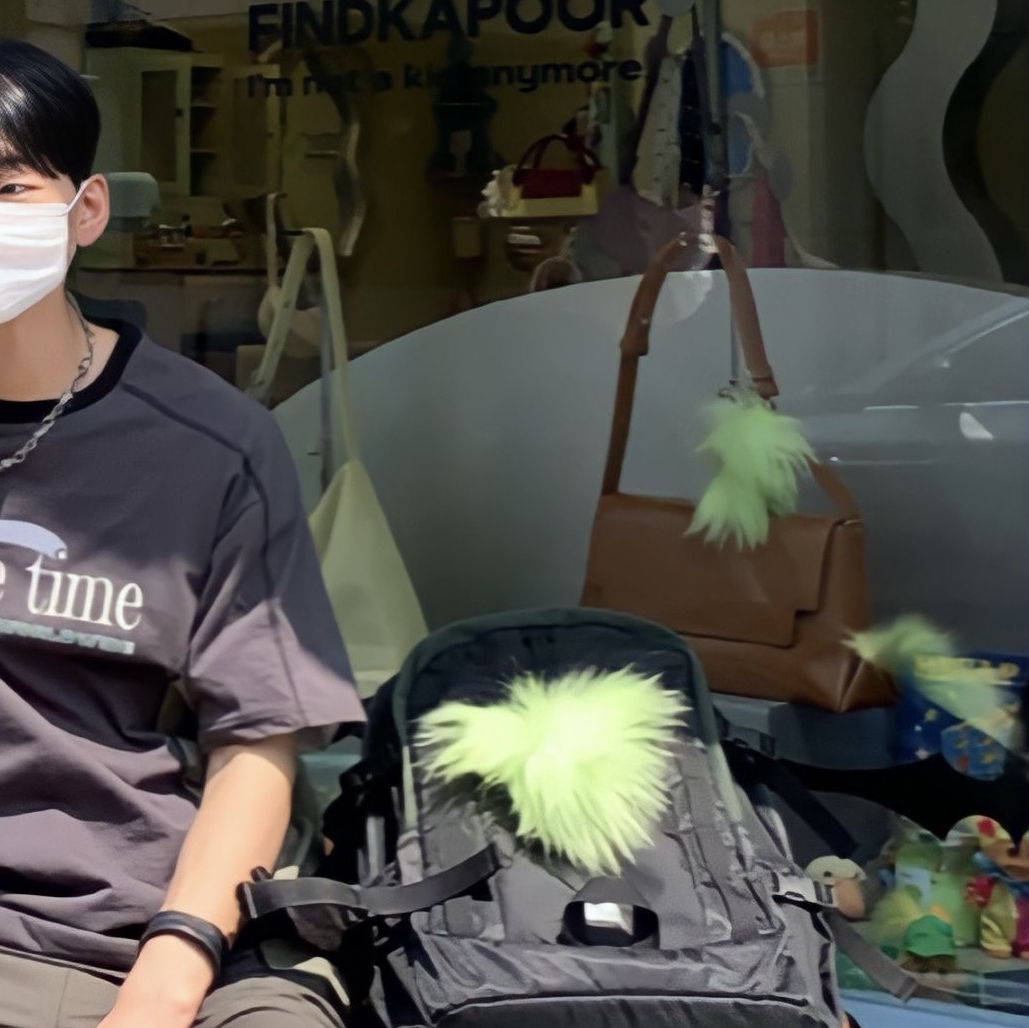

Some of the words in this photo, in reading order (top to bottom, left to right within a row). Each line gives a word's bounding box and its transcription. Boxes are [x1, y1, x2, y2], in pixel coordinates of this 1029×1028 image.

[249, 0, 650, 51] FINDKAPOOR
[303, 71, 361, 95] nt
[405, 62, 452, 89] ki
[24, 548, 143, 631] time
